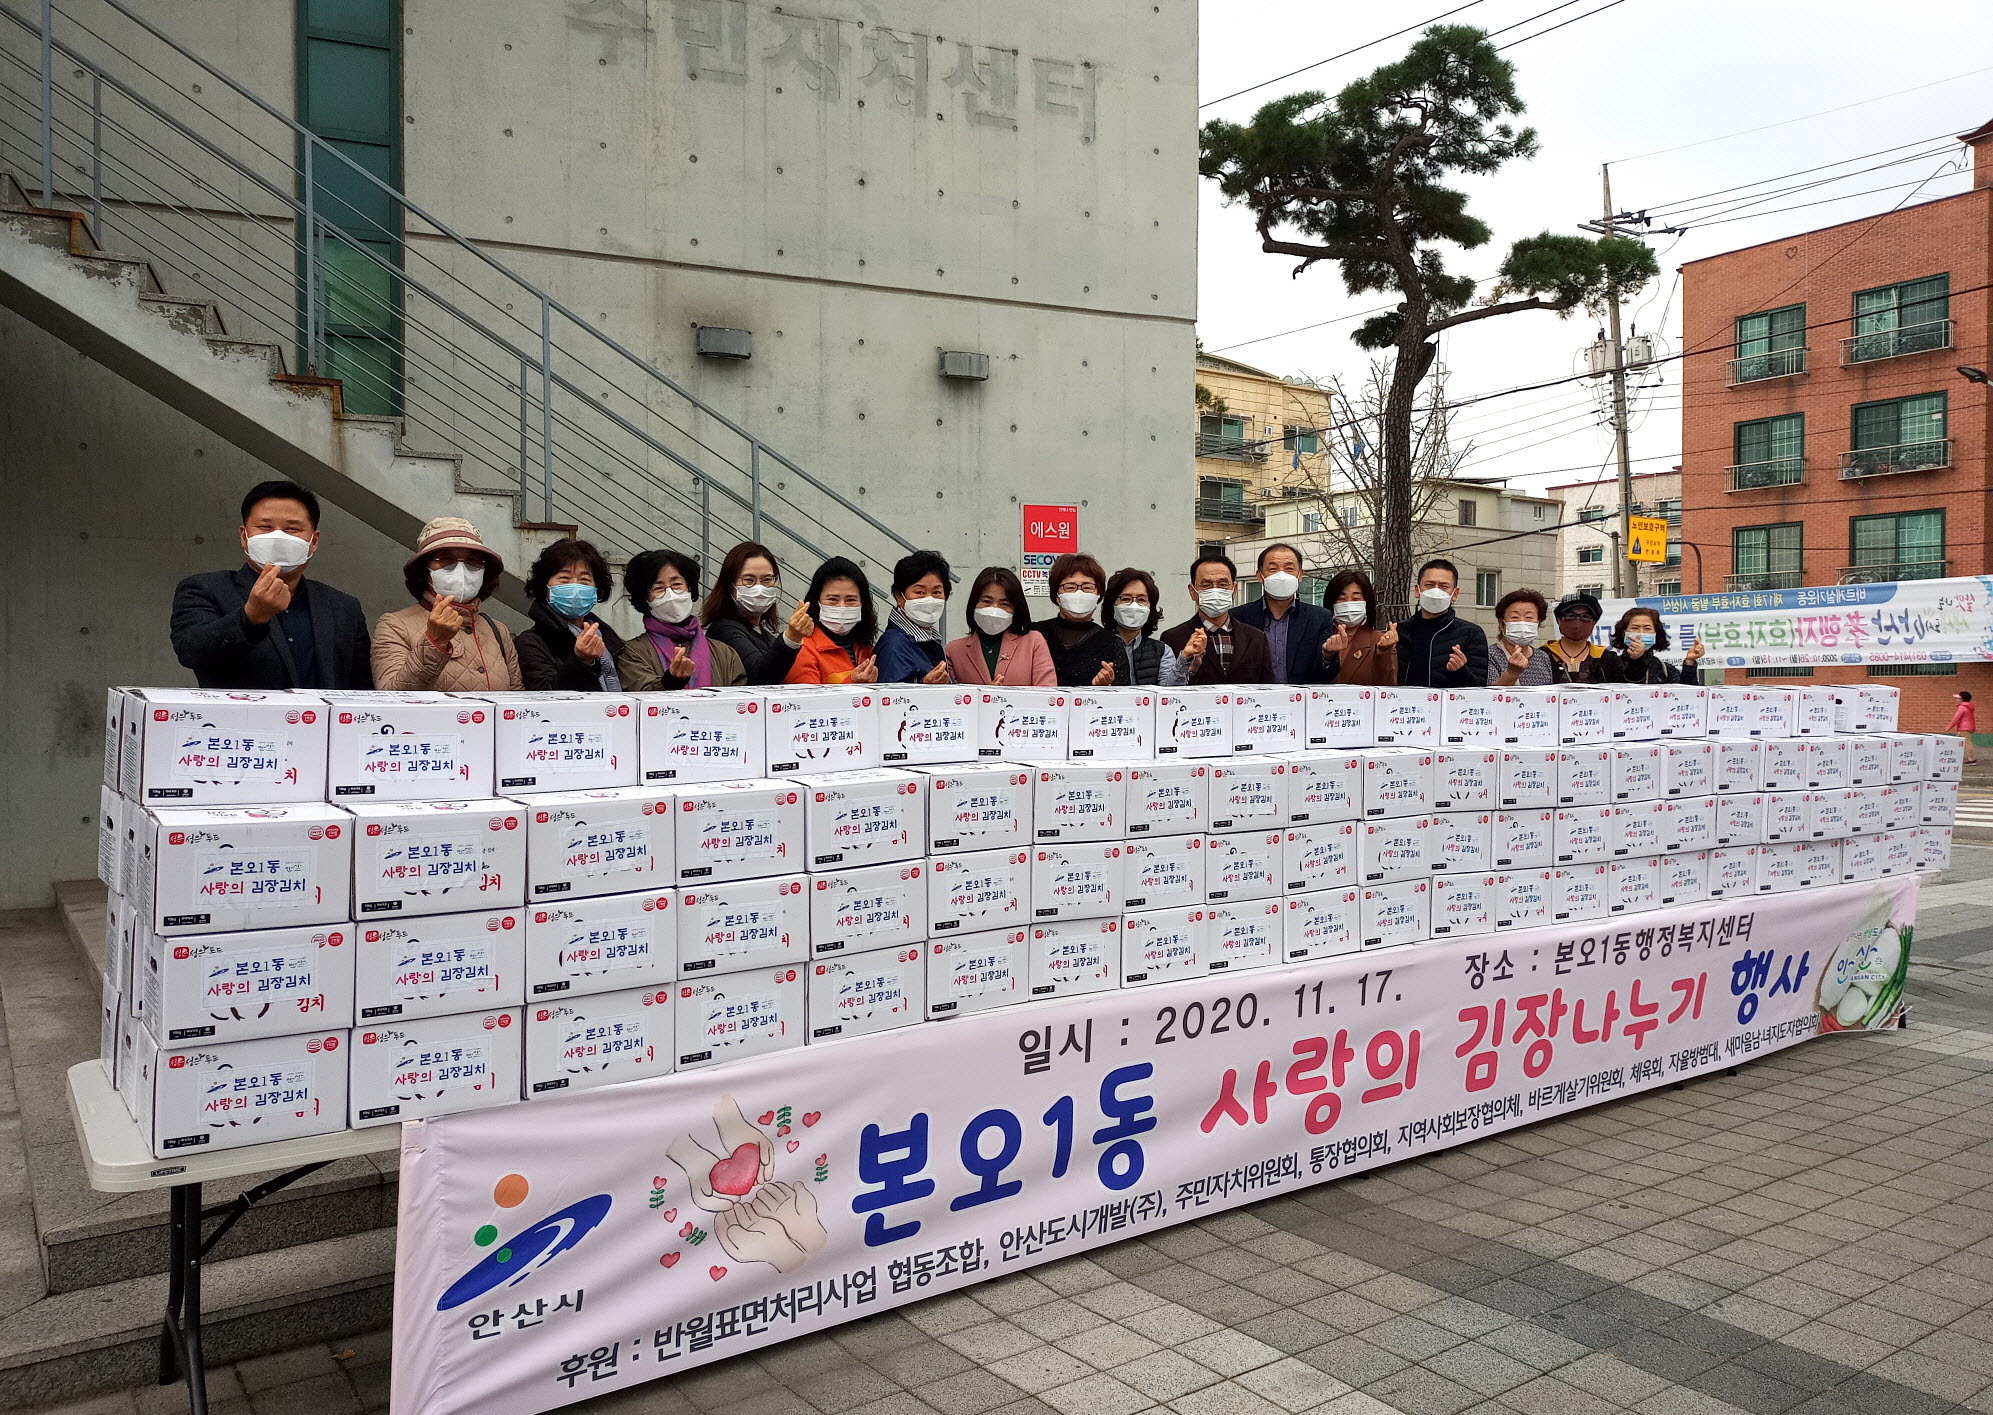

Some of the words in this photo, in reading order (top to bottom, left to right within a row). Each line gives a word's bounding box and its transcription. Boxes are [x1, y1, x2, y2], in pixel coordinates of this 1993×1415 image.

[1030, 521, 1070, 539] 에스원
[1632, 522, 1665, 532] 노인보호구역
[1022, 570, 1041, 578] CCTV
[208, 738, 254, 751] 본오1동
[548, 733, 584, 744] 본오1동
[690, 731, 722, 742] 본오1동
[389, 744, 431, 756] 본오1동
[526, 750, 558, 760] 사랑의
[565, 748, 603, 760] 김장김치
[671, 745, 698, 755] 사랑의
[704, 746, 738, 757] 김장김치
[179, 755, 219, 767] 사랑의
[227, 757, 277, 769] 김장김치
[365, 761, 400, 772] 사랑의
[408, 760, 453, 771] 김장김치
[721, 819, 754, 832] 본오1동
[588, 831, 625, 847] 본오1동
[701, 837, 730, 849] 사랑의
[736, 834, 772, 847] 김장김치
[408, 844, 452, 859] 본오1동
[567, 852, 599, 866] 사랑의
[606, 845, 646, 861] 김장김치
[230, 860, 280, 875] 본오1동
[382, 865, 420, 878] 사랑의
[428, 860, 476, 875] 김장김치
[200, 881, 243, 895] 사랑의
[252, 879, 305, 893] 김장김치
[725, 912, 759, 926] 본오1동
[590, 928, 627, 943] 본오1동
[705, 931, 734, 944] 사랑의
[740, 927, 777, 940] 김장김치
[422, 949, 465, 965] 본오1동
[567, 948, 600, 962] 사랑의
[607, 943, 648, 958] 김장김치
[1465, 950, 1514, 989] 장소
[1554, 912, 1754, 975] 본오1동행정복지센터
[236, 958, 284, 976] 본오1동
[396, 971, 433, 985] 사랑의
[441, 965, 488, 981] 김장김치
[208, 981, 249, 996] 사랑의
[258, 974, 310, 991] 김장김치
[297, 994, 325, 1012] 김치
[726, 1001, 759, 1017] 본오1동
[708, 1021, 736, 1035] 사랑의
[742, 1013, 777, 1029] 김장김치
[1019, 1018, 1091, 1075] 일시
[1155, 992, 1270, 1045] 2020.
[1294, 981, 1335, 1018] 11.
[1358, 970, 1402, 1006] 17.
[586, 1024, 623, 1040] 본오1동
[564, 1045, 596, 1058] 사랑의
[603, 1037, 643, 1053] 김장김치
[420, 1049, 462, 1066] 본오1동
[234, 1073, 282, 1091] 본오1동
[395, 1070, 431, 1085] 사랑의
[439, 1063, 485, 1080] 김장김치
[205, 1096, 247, 1111] 사랑의
[256, 1088, 307, 1106] 김장김치
[851, 1061, 1157, 1247] 본오1동
[1200, 1028, 1421, 1136] 사랑의
[1455, 971, 1707, 1093] 김장나누기
[1730, 947, 1810, 1025] 행사
[556, 1343, 618, 1388] 후원
[653, 1266, 877, 1361] 반월표면처리사업
[888, 1239, 989, 1293] 협동조합,
[999, 1191, 1167, 1261] 안산도시개발(주),
[1174, 1151, 1303, 1209] 주민자치위원회,
[1309, 1131, 1391, 1175] 통장협의회,
[1397, 1095, 1523, 1148] 지역사회보장협의체,
[1528, 1067, 1625, 1111] 바르게살기위원회,
[1629, 1056, 1664, 1085] 체육회,
[1667, 1041, 1721, 1073] 자율방범대,
[468, 1289, 584, 1341] 안산시
